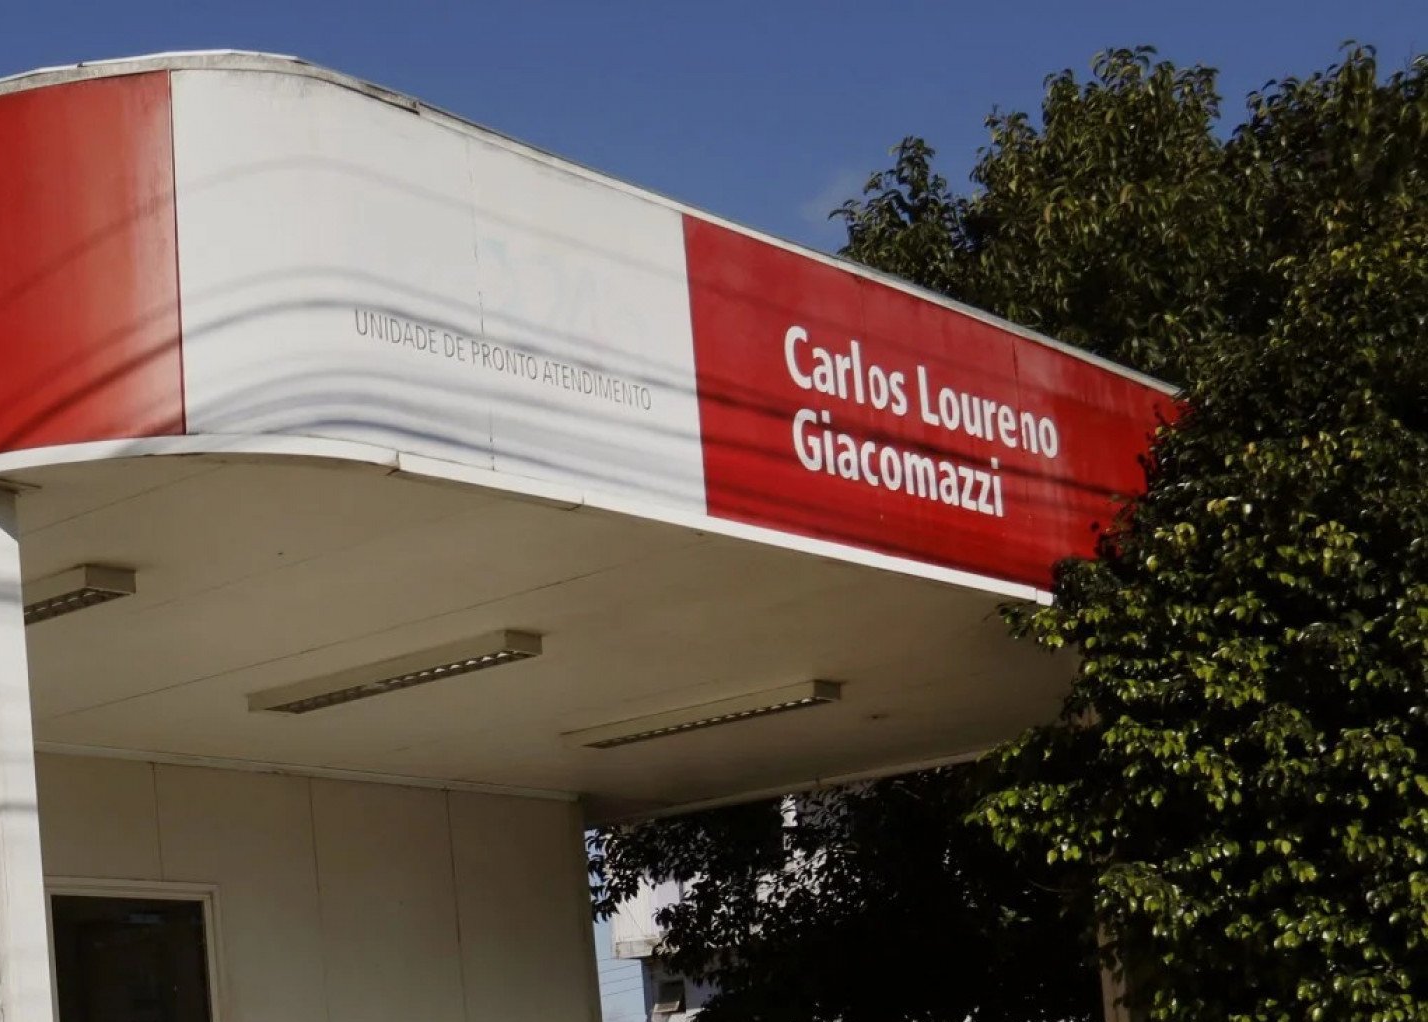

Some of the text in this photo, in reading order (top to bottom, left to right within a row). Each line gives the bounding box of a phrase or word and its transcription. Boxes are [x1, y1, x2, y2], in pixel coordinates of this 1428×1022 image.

[354, 309, 652, 411] UNIDADE DE PRONTO ATENDIMENTO
[783, 325, 1059, 460] Carlos Loureno
[792, 408, 1005, 519] Giacomazzi
